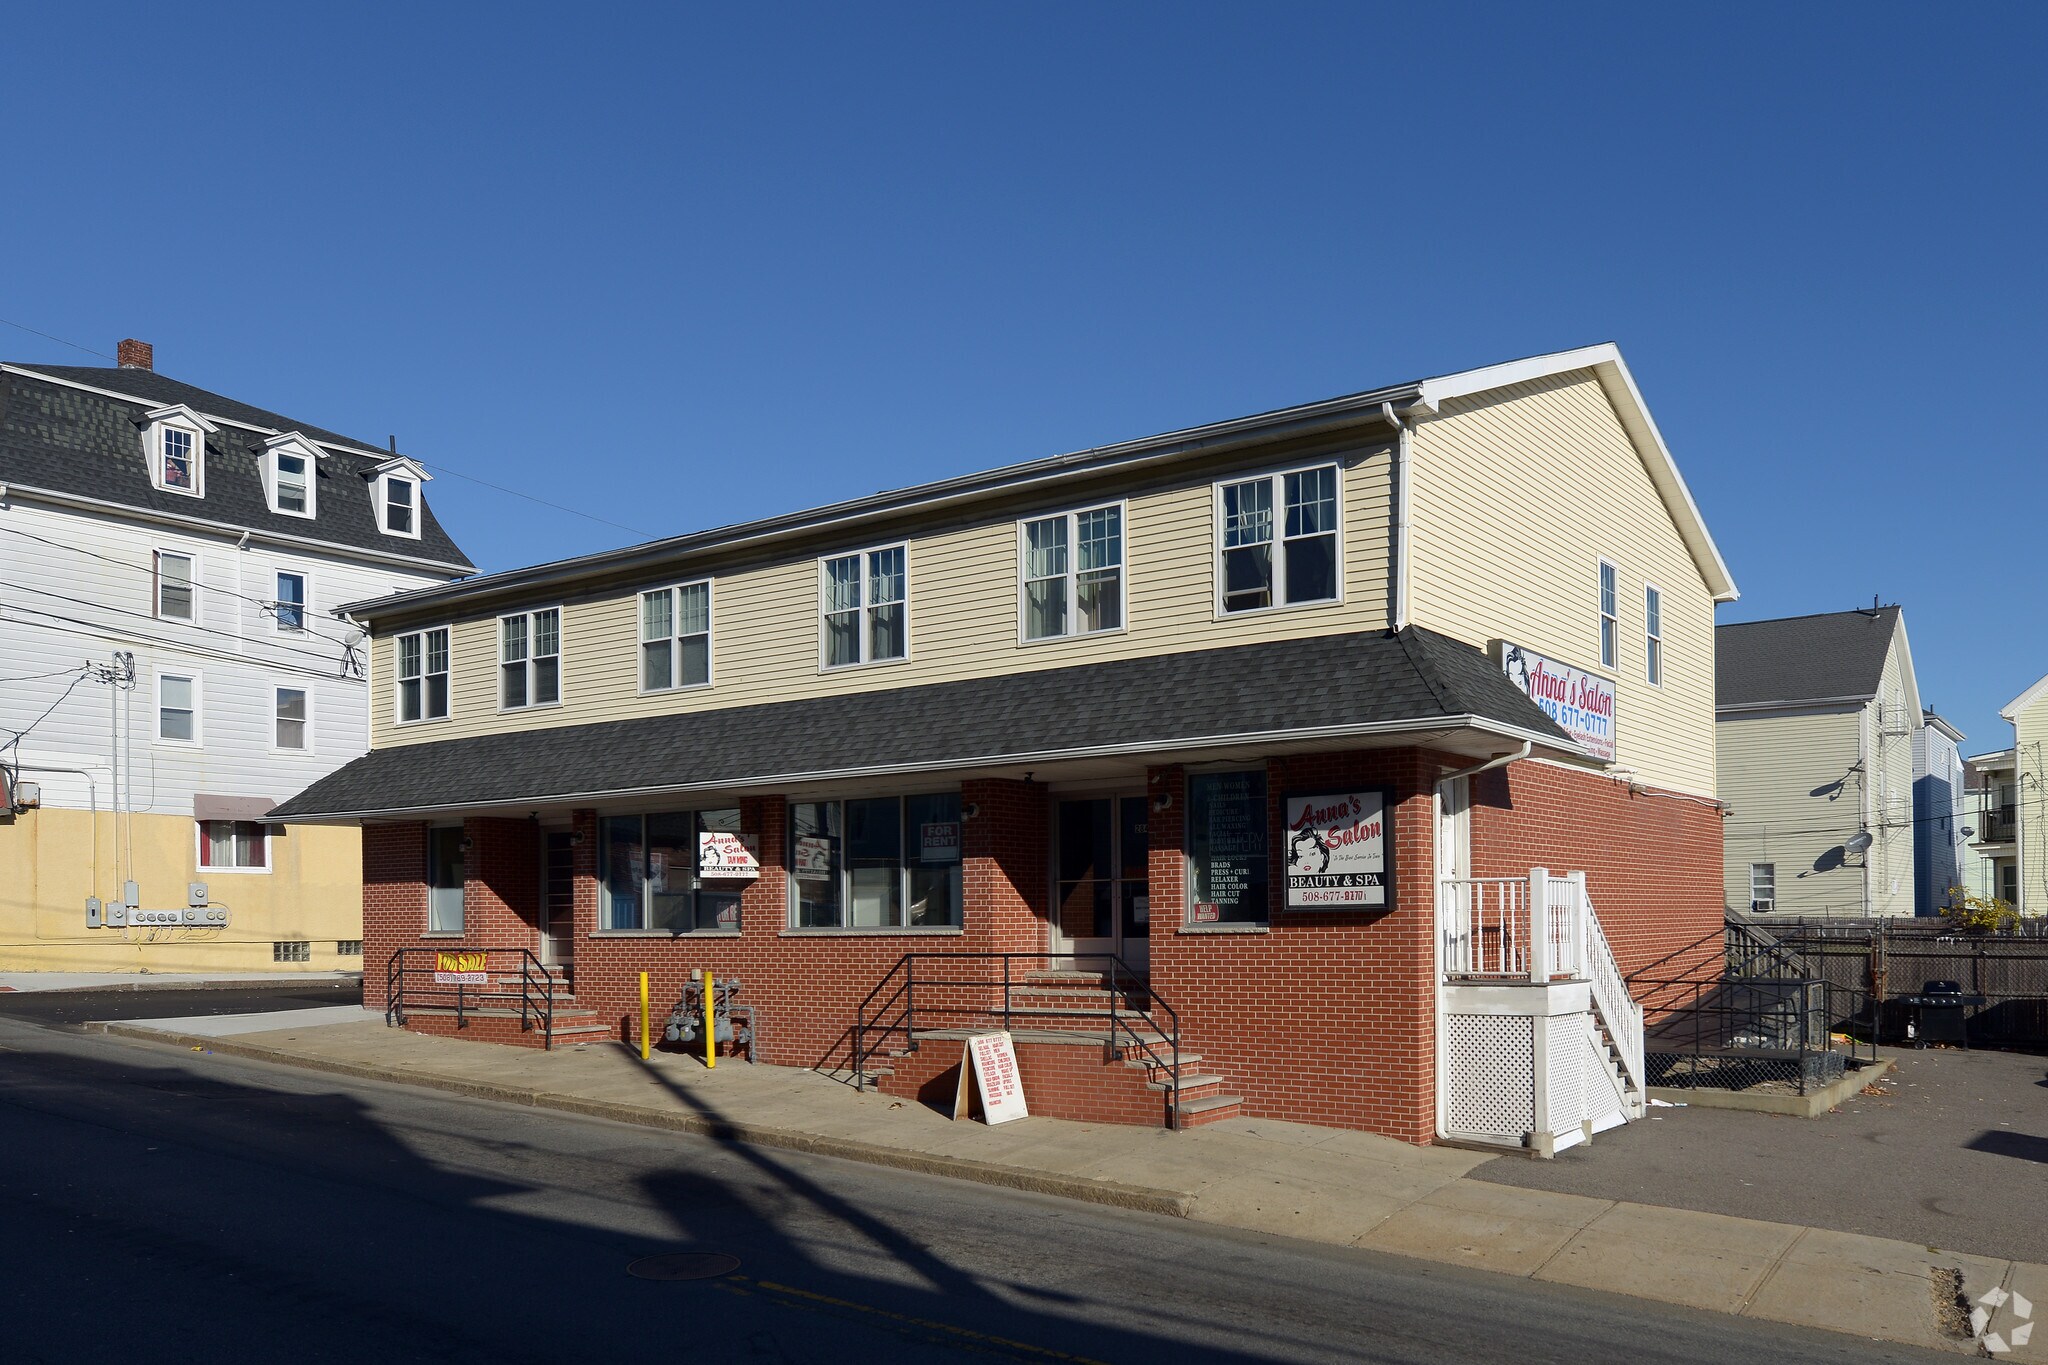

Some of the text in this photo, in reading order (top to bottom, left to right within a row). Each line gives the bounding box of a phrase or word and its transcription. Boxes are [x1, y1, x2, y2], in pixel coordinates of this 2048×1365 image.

[1530, 659, 1612, 717] Anna's Salon
[1562, 705, 1607, 736] 677-0777
[1290, 796, 1361, 831] Anna's
[924, 836, 956, 846] RENT
[928, 827, 952, 836] FOR
[1325, 819, 1381, 850] Salon
[723, 844, 756, 854] Salon
[1290, 874, 1380, 888] BEAUTY & SPA
[437, 953, 488, 972] FOR SALE
